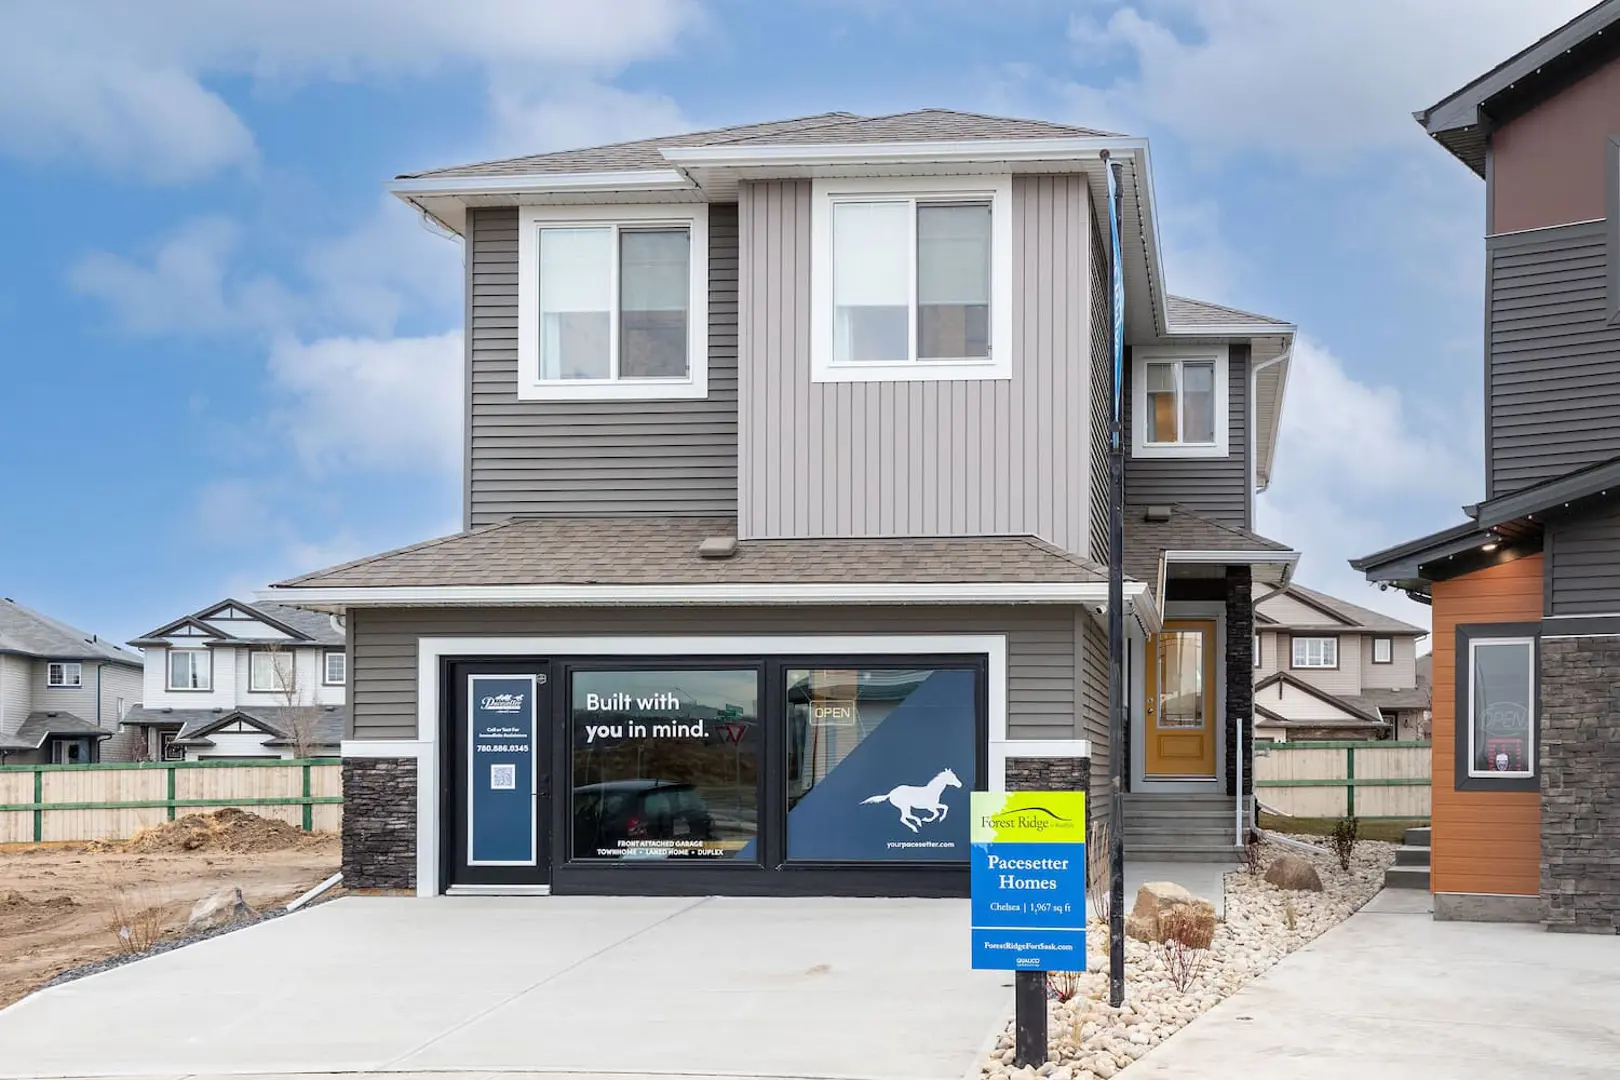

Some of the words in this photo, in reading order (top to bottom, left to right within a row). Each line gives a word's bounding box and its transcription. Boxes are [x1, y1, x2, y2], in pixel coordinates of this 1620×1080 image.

[586, 692, 632, 711] Built
[636, 692, 680, 711] with
[814, 707, 851, 718] OPEN
[1484, 711, 1525, 727] OPEN
[585, 725, 623, 743] you
[628, 720, 647, 738] in
[652, 719, 710, 738] mind.
[980, 816, 1014, 828] Forest
[1018, 815, 1049, 832] Ridge
[887, 841, 955, 849] yourpacesetter.com
[987, 855, 1069, 870] Pacesetter
[998, 874, 1057, 890] Homes
[990, 902, 1020, 911] Chelsea
[1030, 902, 1051, 913] 1,967
[1053, 905, 1063, 914] sq
[1064, 903, 1072, 912] ft
[984, 942, 1073, 952] ForestRidgeFortSask.com
